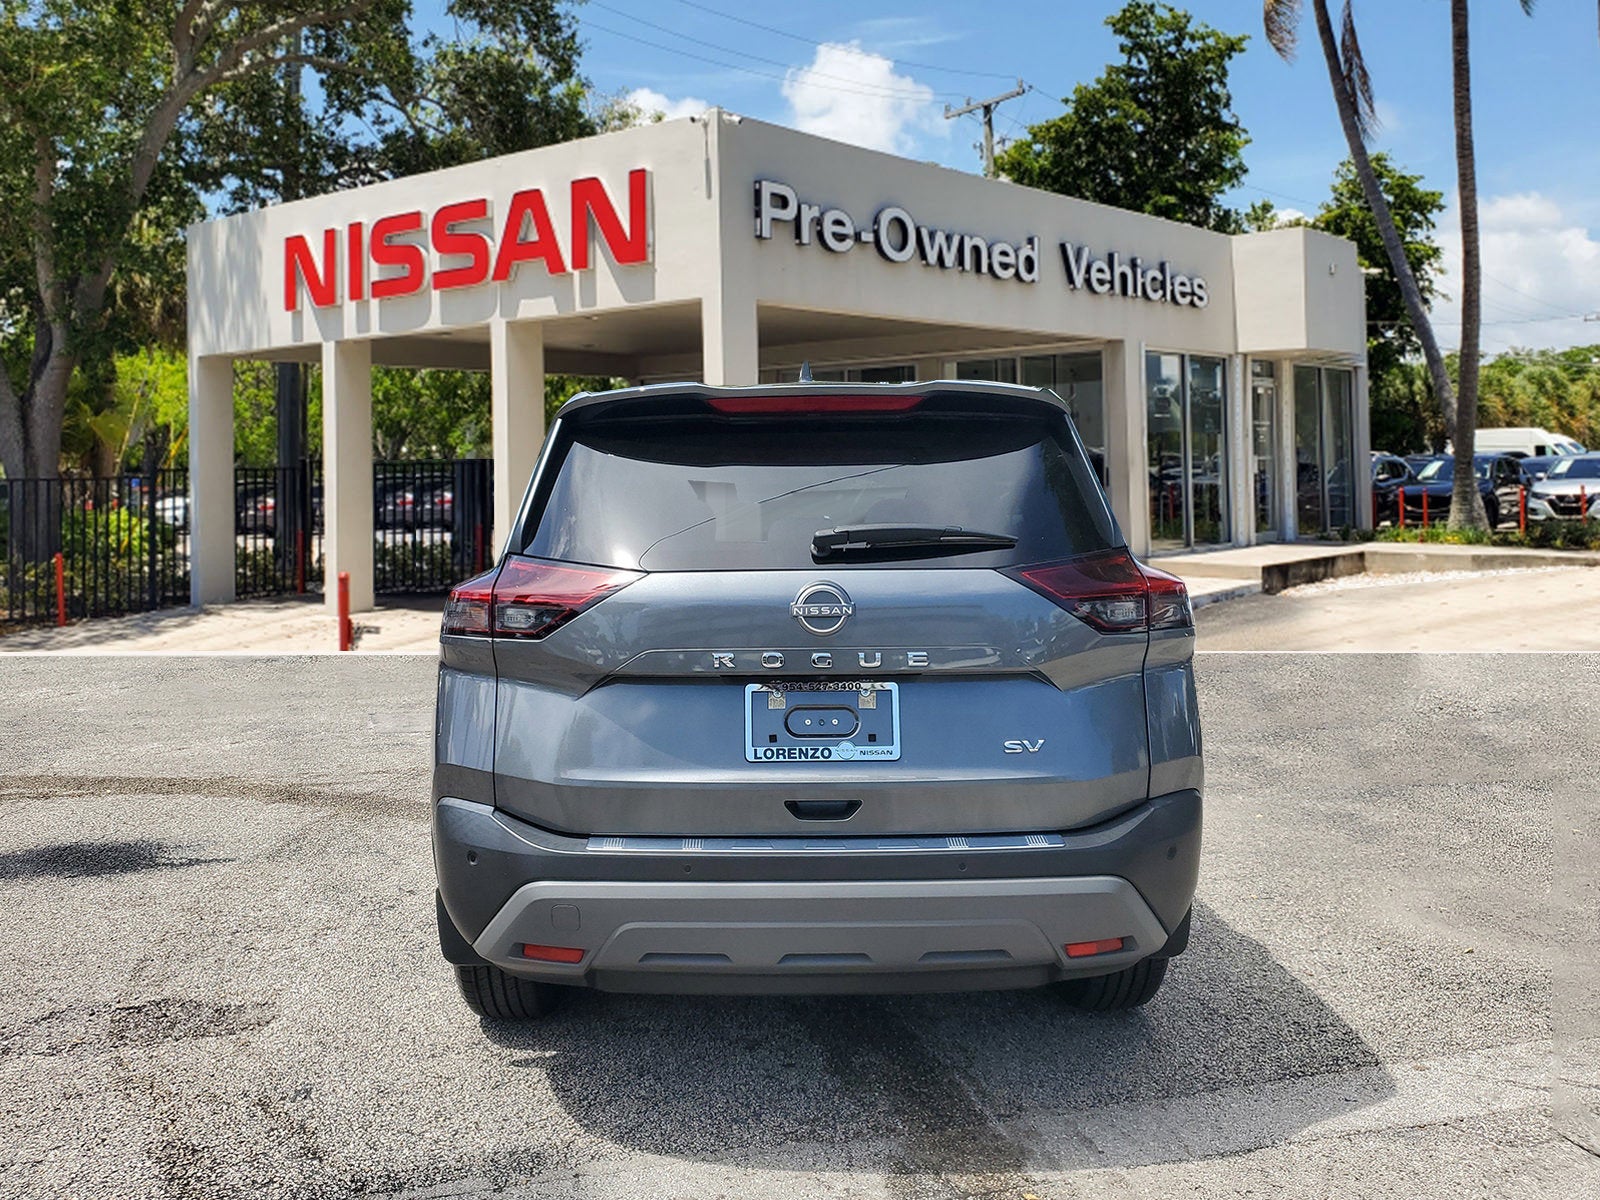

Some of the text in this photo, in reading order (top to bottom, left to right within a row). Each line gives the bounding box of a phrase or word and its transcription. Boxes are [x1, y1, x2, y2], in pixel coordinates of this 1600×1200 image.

[285, 168, 647, 311] NISSAN
[754, 179, 1209, 308] Pre-Owned Vehicles
[793, 606, 852, 615] NISSAN
[711, 652, 930, 668] ROGUE
[753, 747, 832, 760] LORENZO
[1003, 739, 1045, 754] SV
